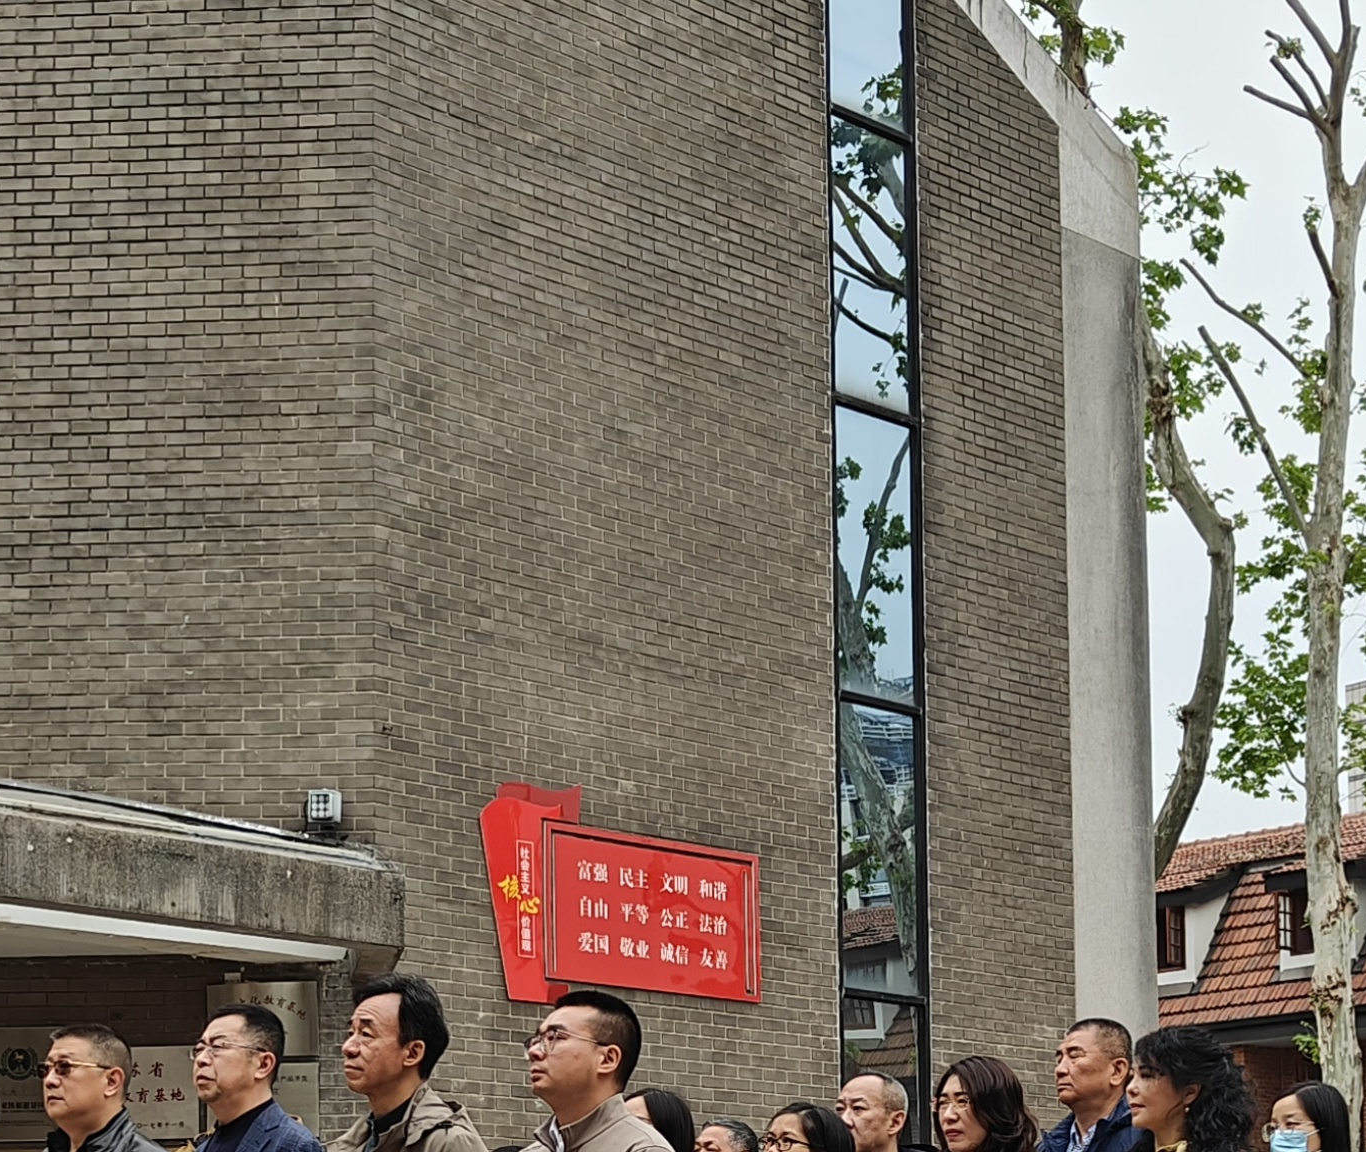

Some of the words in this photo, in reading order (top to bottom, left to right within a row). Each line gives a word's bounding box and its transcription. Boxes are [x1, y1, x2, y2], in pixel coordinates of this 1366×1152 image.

[519, 846, 531, 896] 社会主义
[577, 859, 609, 884] 富强
[619, 866, 649, 890] 民主
[659, 872, 689, 896] 文明
[698, 878, 727, 902] 和谐
[497, 873, 541, 915] 核心
[520, 915, 532, 953] 价值观
[579, 895, 609, 920] 自由
[619, 902, 650, 925] 平等
[660, 907, 690, 930] 公正
[698, 913, 728, 936] 法治
[578, 931, 610, 956] 爱国
[619, 936, 650, 960] 敬业
[660, 942, 690, 966] 诚信
[699, 947, 729, 971] 友善
